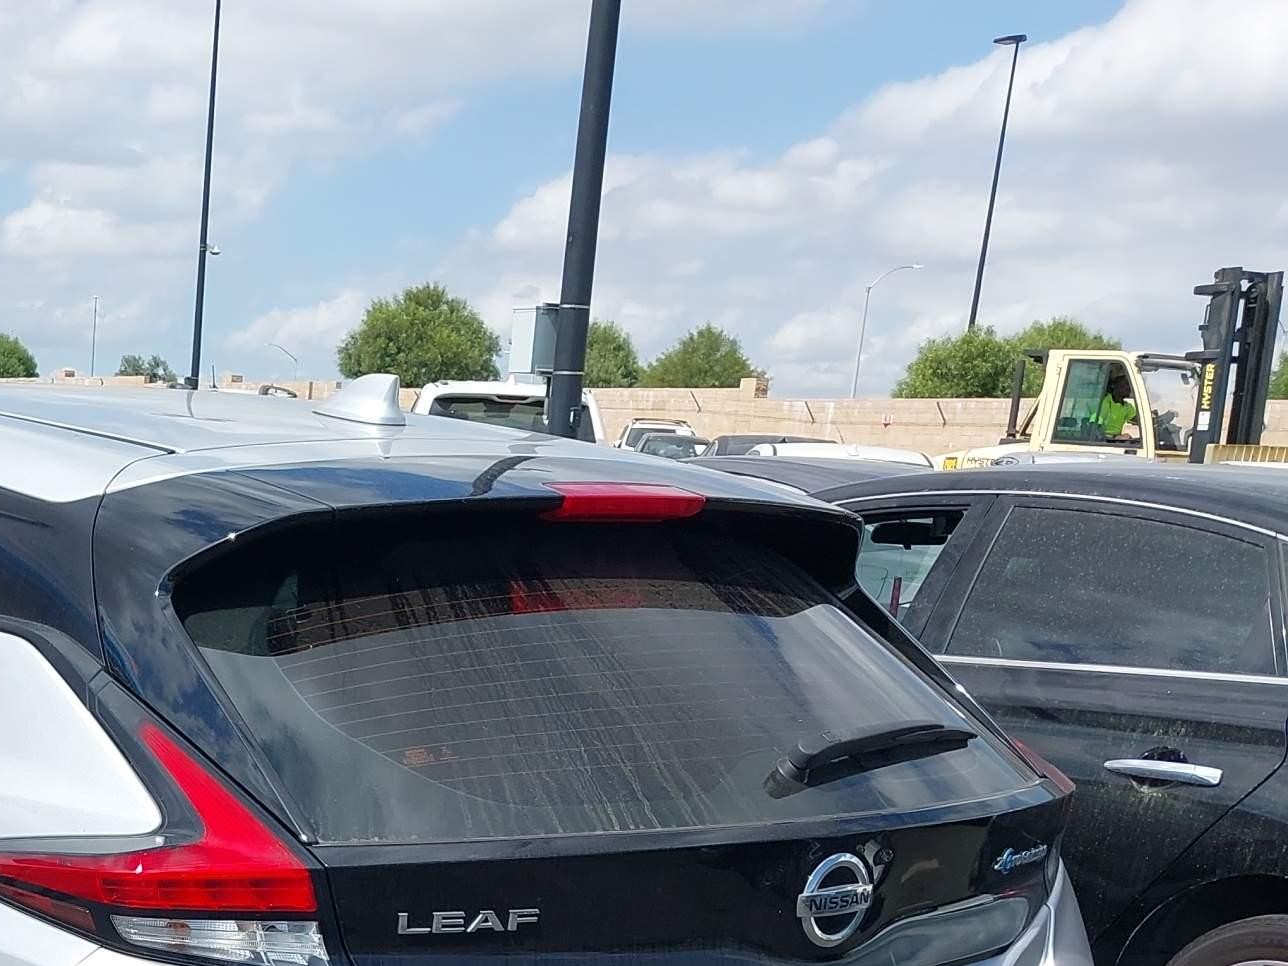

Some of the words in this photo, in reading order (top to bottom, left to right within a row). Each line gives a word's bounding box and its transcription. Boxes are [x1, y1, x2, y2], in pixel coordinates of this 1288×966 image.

[1201, 363, 1216, 409] HYSTER
[808, 889, 870, 912] NISSAN
[397, 908, 541, 934] LEAF
